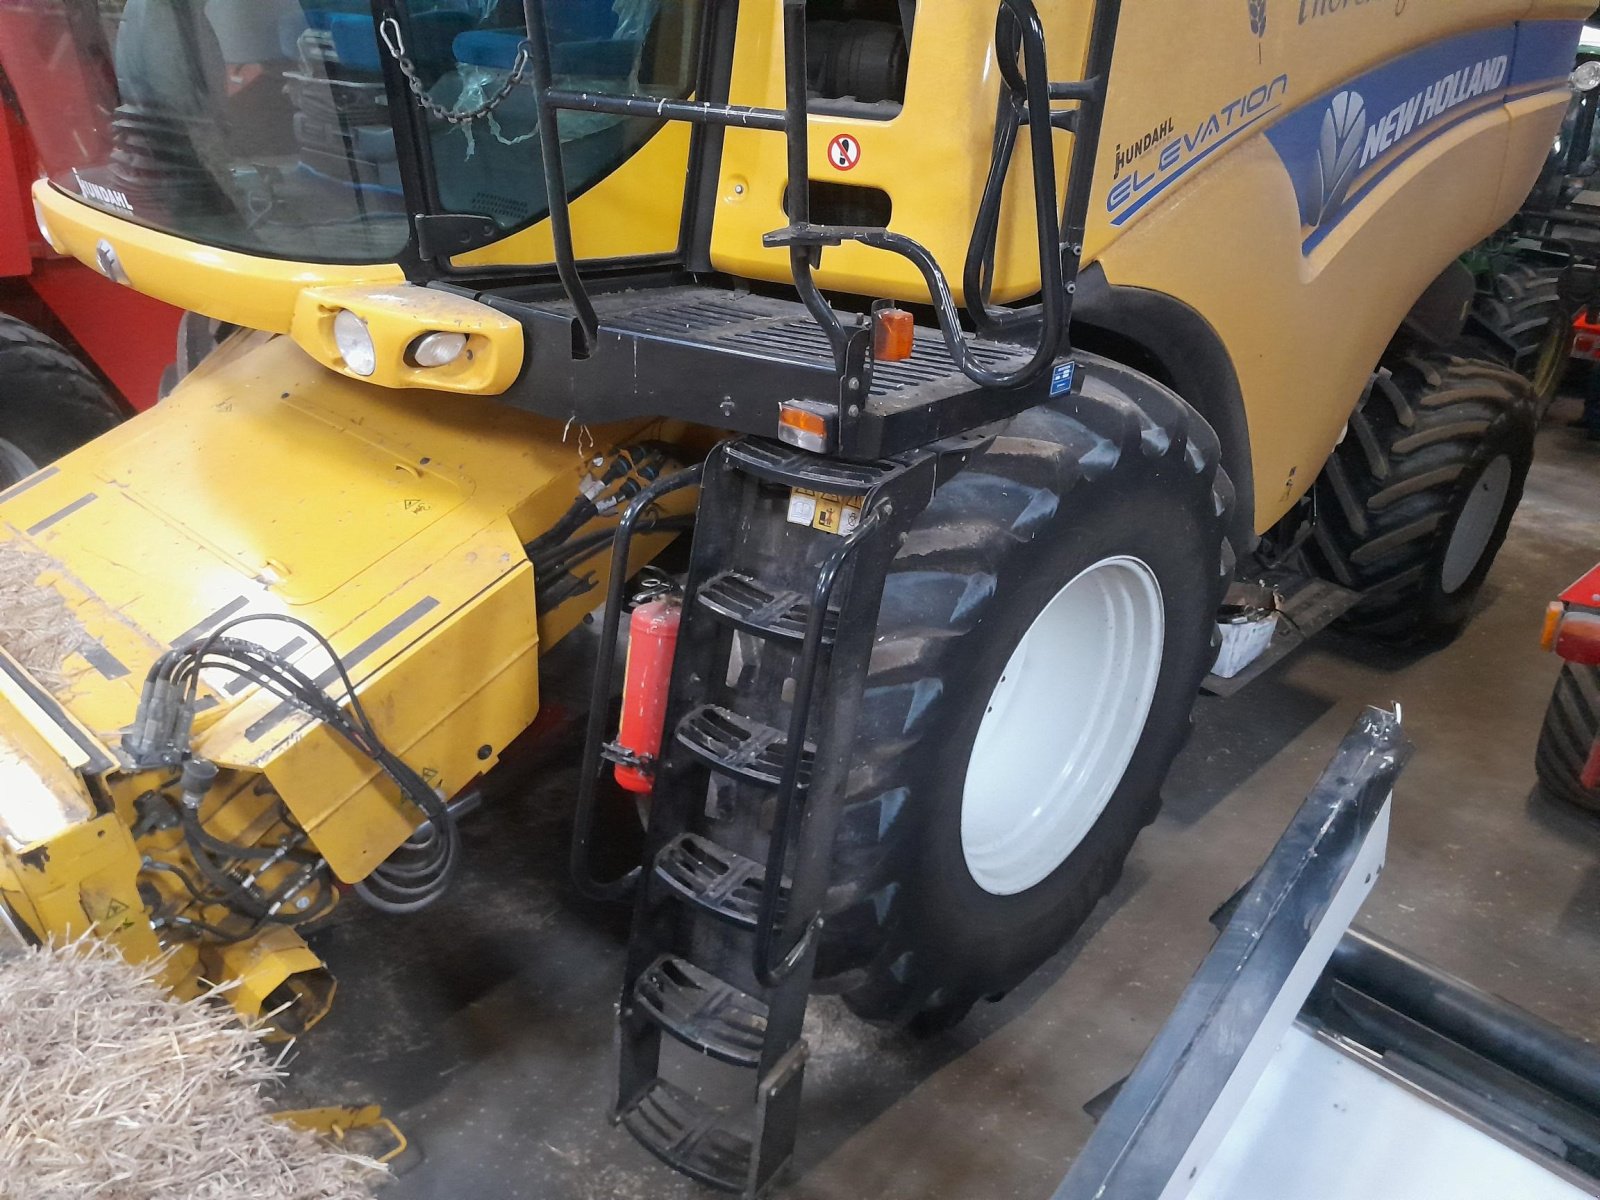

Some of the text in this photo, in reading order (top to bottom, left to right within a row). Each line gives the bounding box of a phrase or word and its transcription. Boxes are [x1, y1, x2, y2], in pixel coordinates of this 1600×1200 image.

[1107, 74, 1287, 212] ELEVATION
[1359, 55, 1507, 168] NEW HOLLAND
